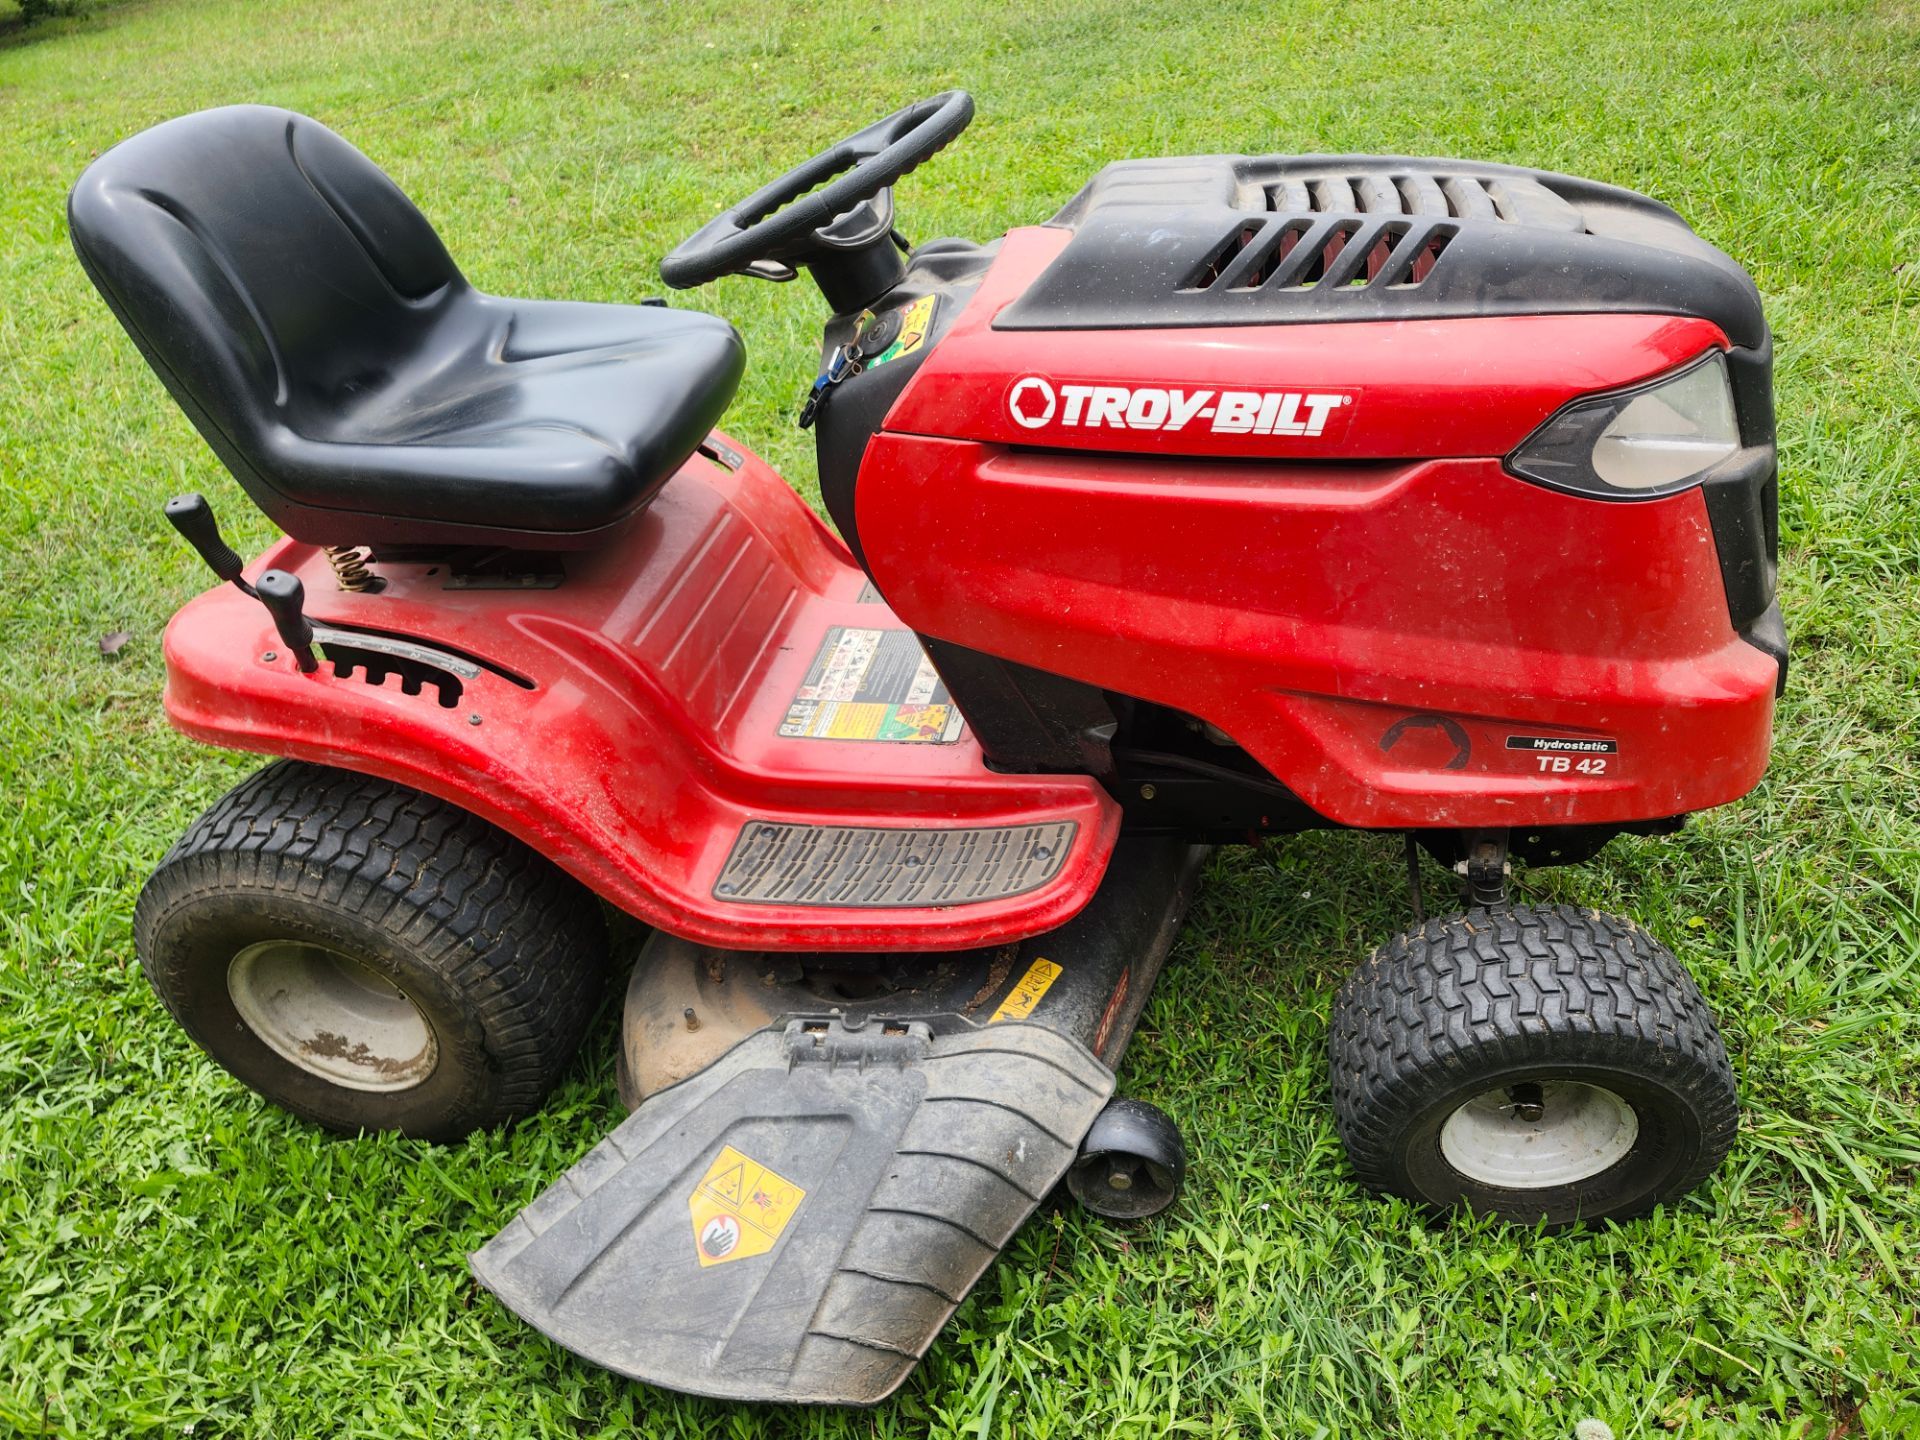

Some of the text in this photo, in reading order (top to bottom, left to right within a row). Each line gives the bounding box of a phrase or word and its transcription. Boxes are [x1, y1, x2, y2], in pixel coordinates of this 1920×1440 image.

[1533, 738, 1609, 752] Hydrostatic
[1536, 755, 1607, 775] TB 42
